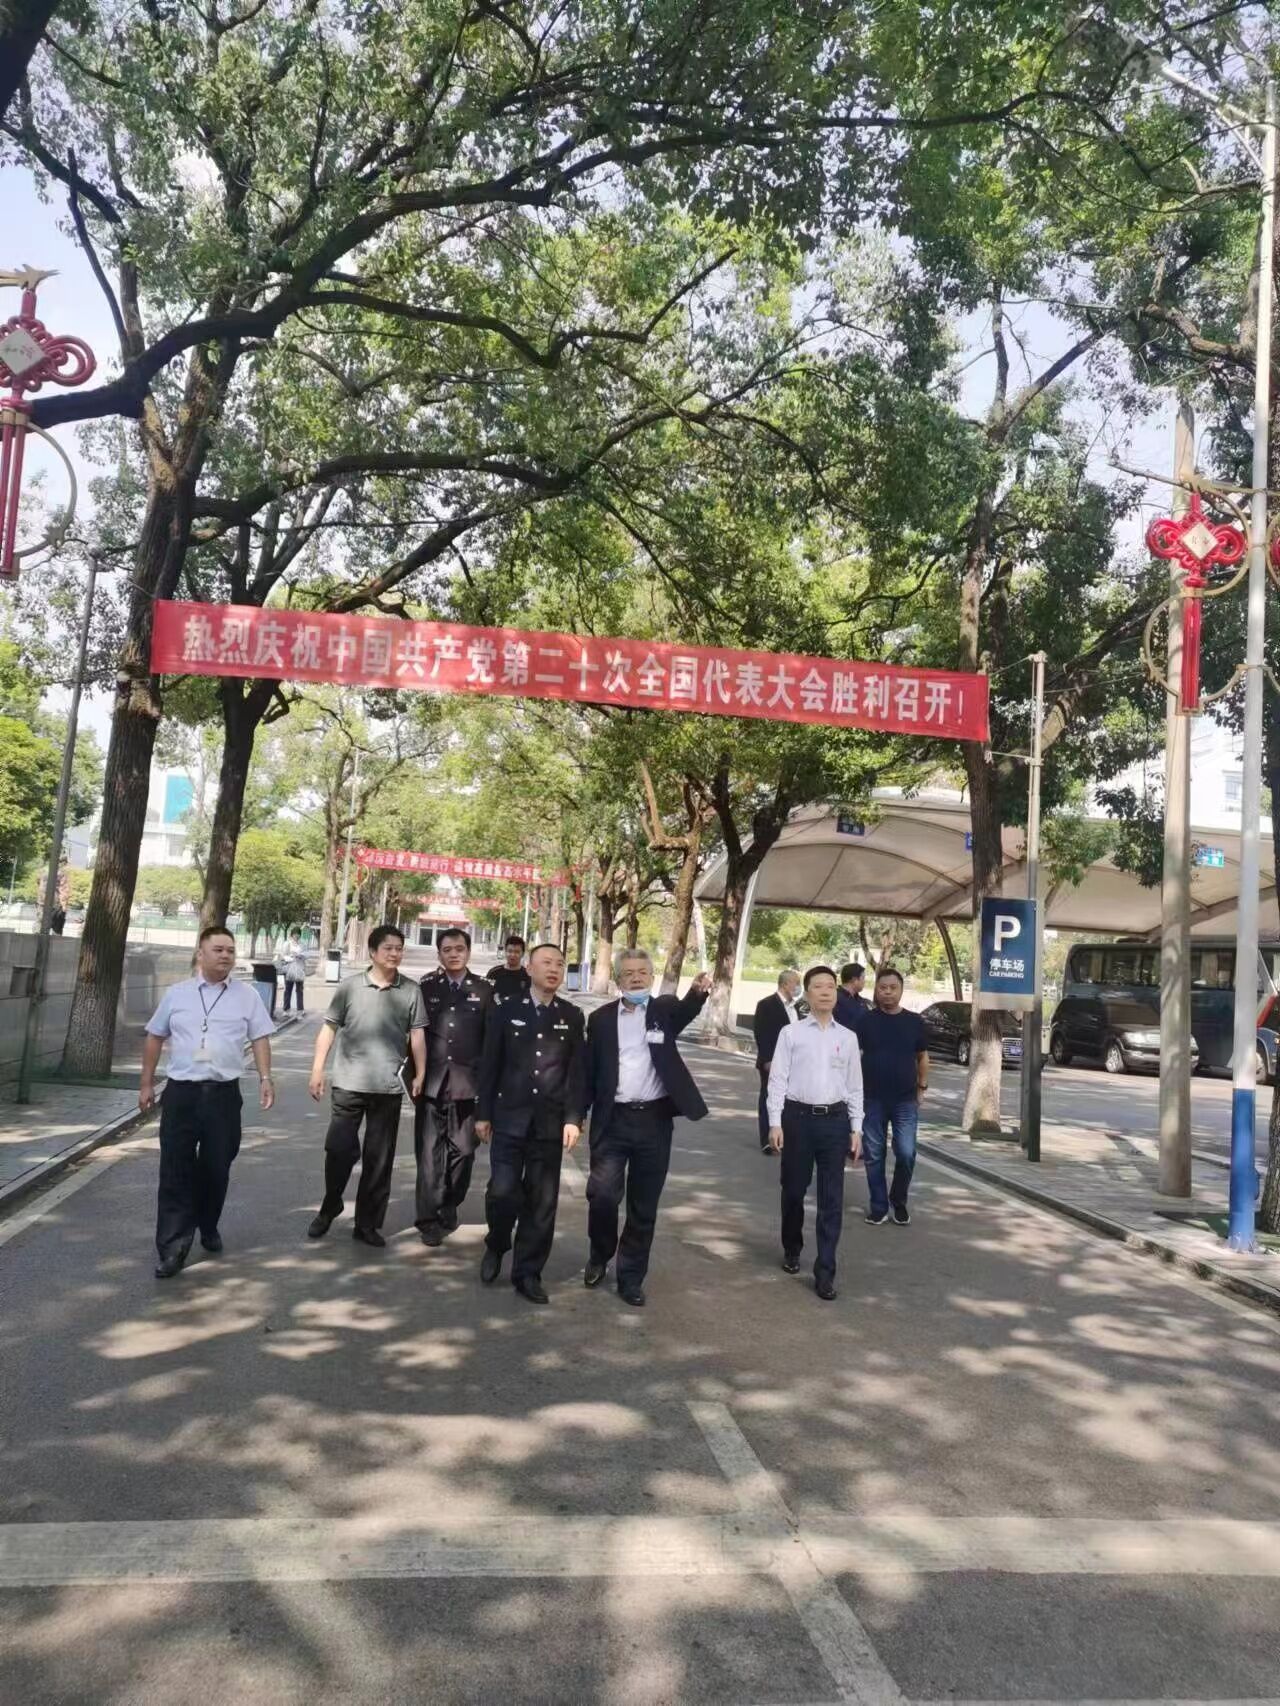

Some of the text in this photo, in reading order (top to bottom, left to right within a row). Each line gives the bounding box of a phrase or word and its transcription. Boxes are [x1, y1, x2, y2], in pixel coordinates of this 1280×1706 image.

[993, 915, 1022, 952] P
[989, 958, 1025, 972] 停车场
